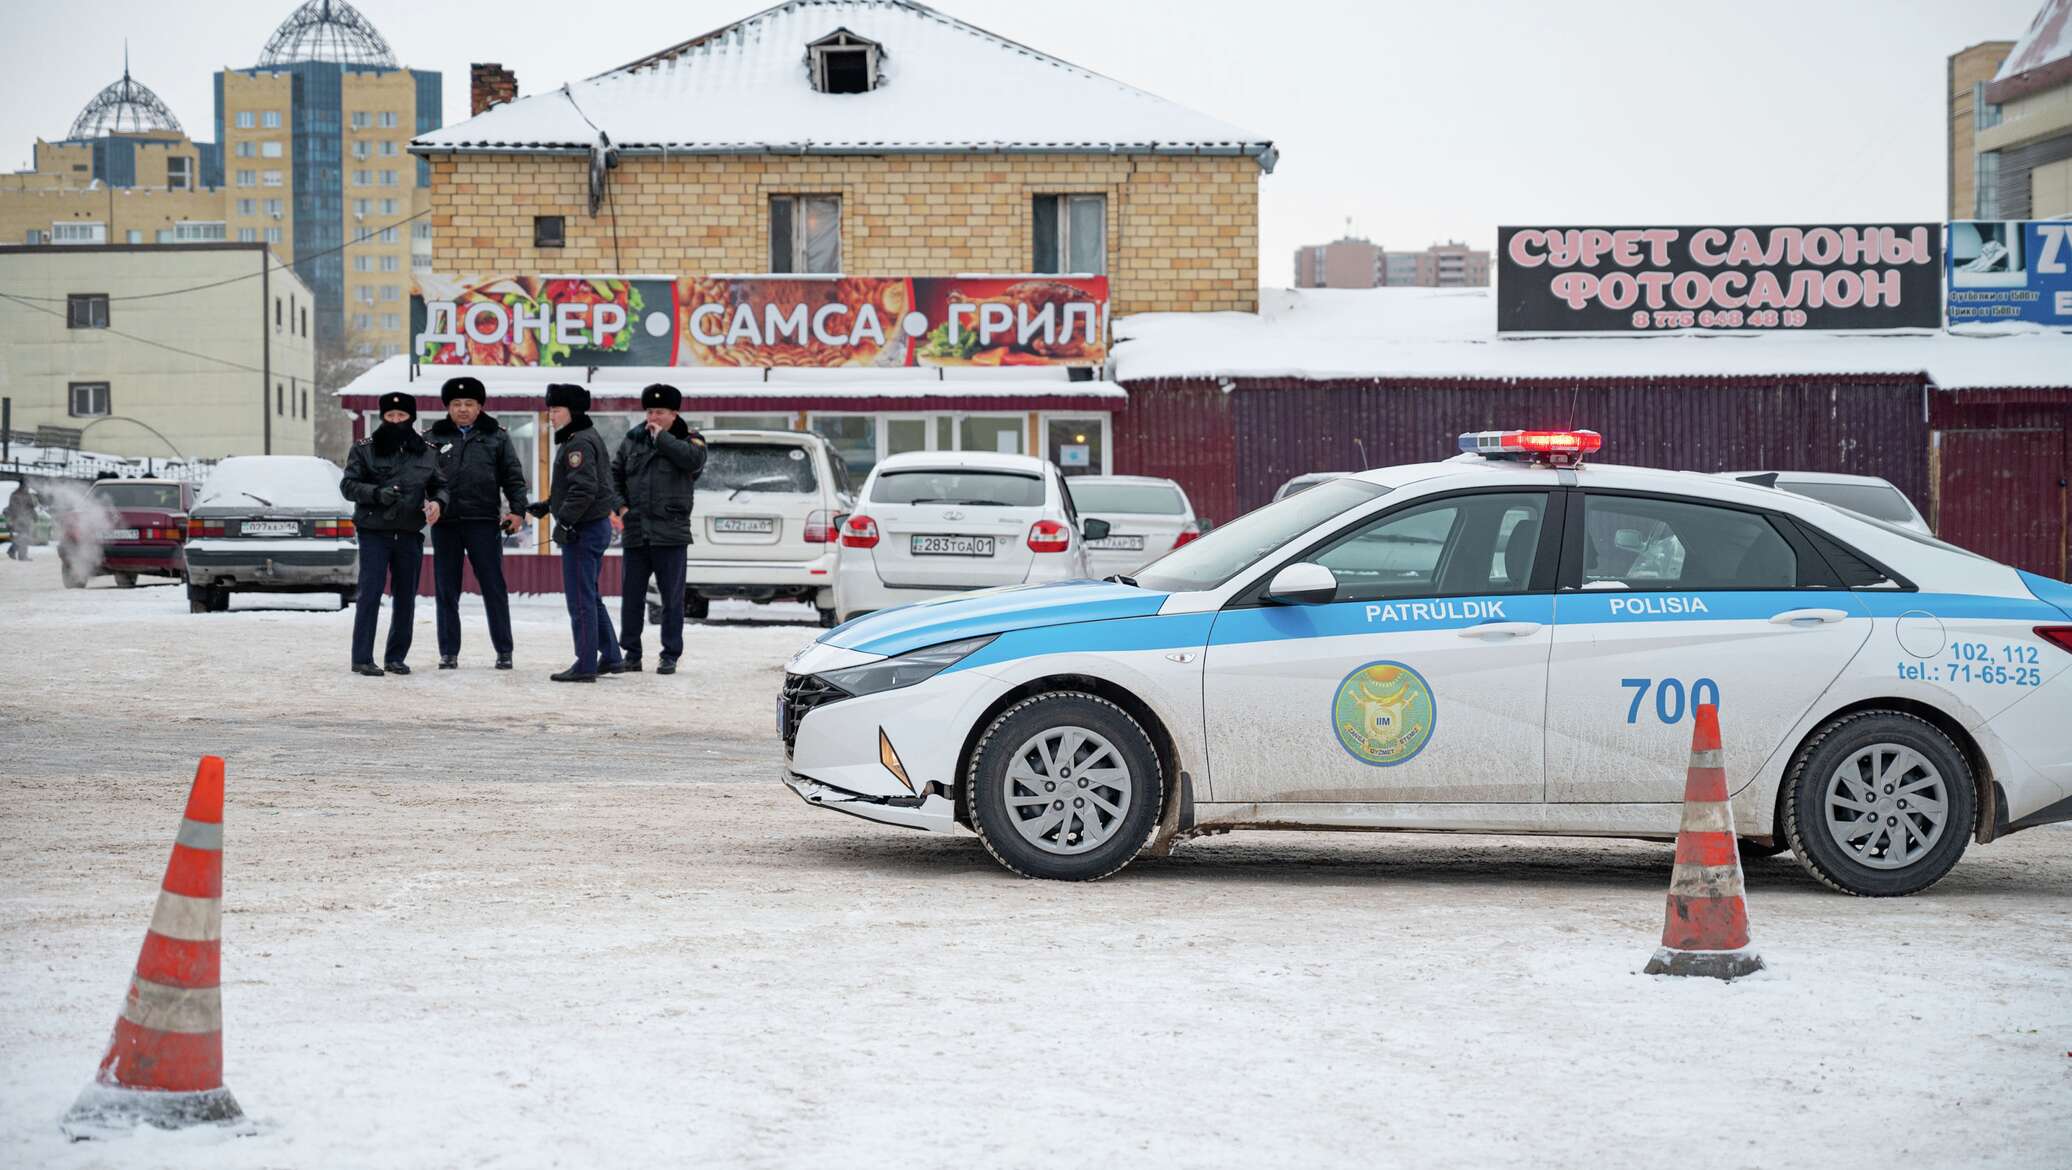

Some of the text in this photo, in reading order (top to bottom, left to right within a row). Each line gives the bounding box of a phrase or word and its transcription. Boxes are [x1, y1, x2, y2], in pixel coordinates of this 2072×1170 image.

[1508, 227, 1931, 267] СУРЕТ САЛОНЫ
[1551, 270, 1901, 310] ФОТОСАЛОН
[415, 301, 1110, 355] ДОНЕР САМСА ГРИЛ
[1633, 311, 1807, 328] 8 775 648 48 19
[1609, 597, 1708, 615] POLISIA
[1950, 642, 2039, 664] 102, 112
[1897, 661, 2041, 686] tel.: 71-65-25
[1620, 678, 1720, 725] 700
[1376, 717, 1390, 726] IIM
